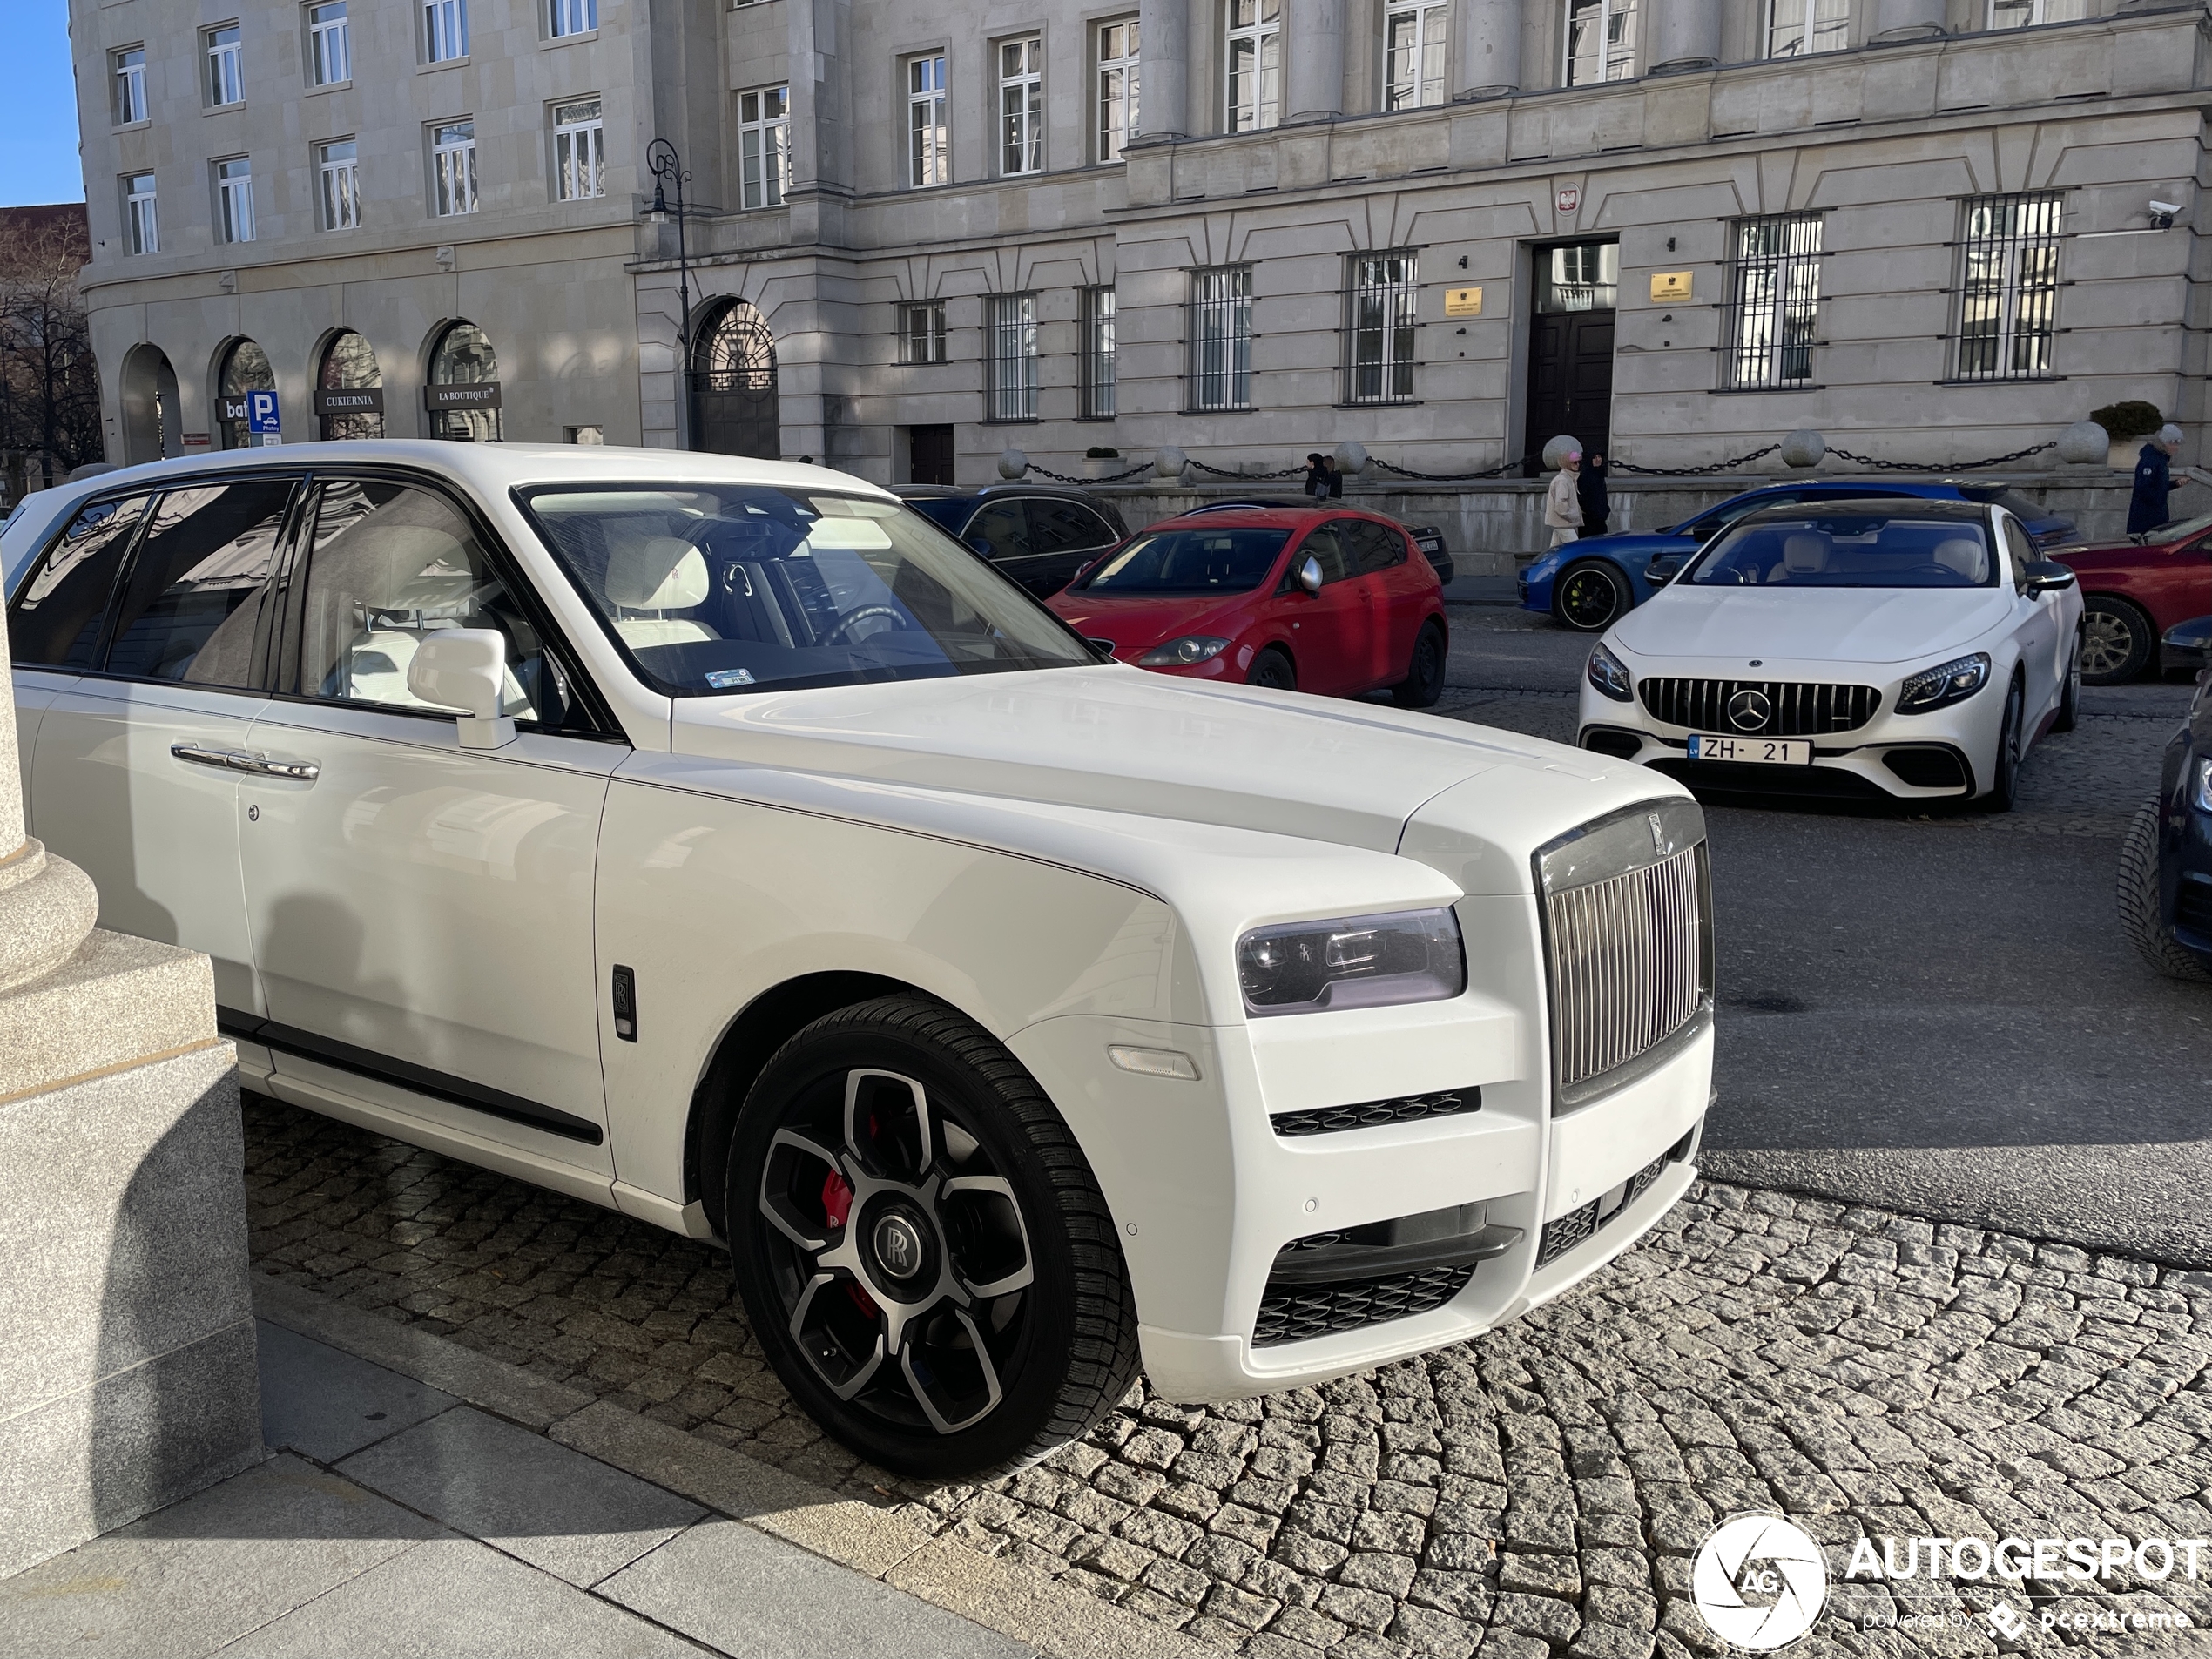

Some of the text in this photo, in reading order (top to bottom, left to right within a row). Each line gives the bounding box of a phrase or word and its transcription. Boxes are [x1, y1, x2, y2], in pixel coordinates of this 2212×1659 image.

[326, 395, 374, 407] CUKIERNIA
[439, 390, 489, 401] LA BOUTIQUE
[254, 395, 273, 421] P
[1764, 743, 1789, 762] 21
[887, 1226, 909, 1268] RR
